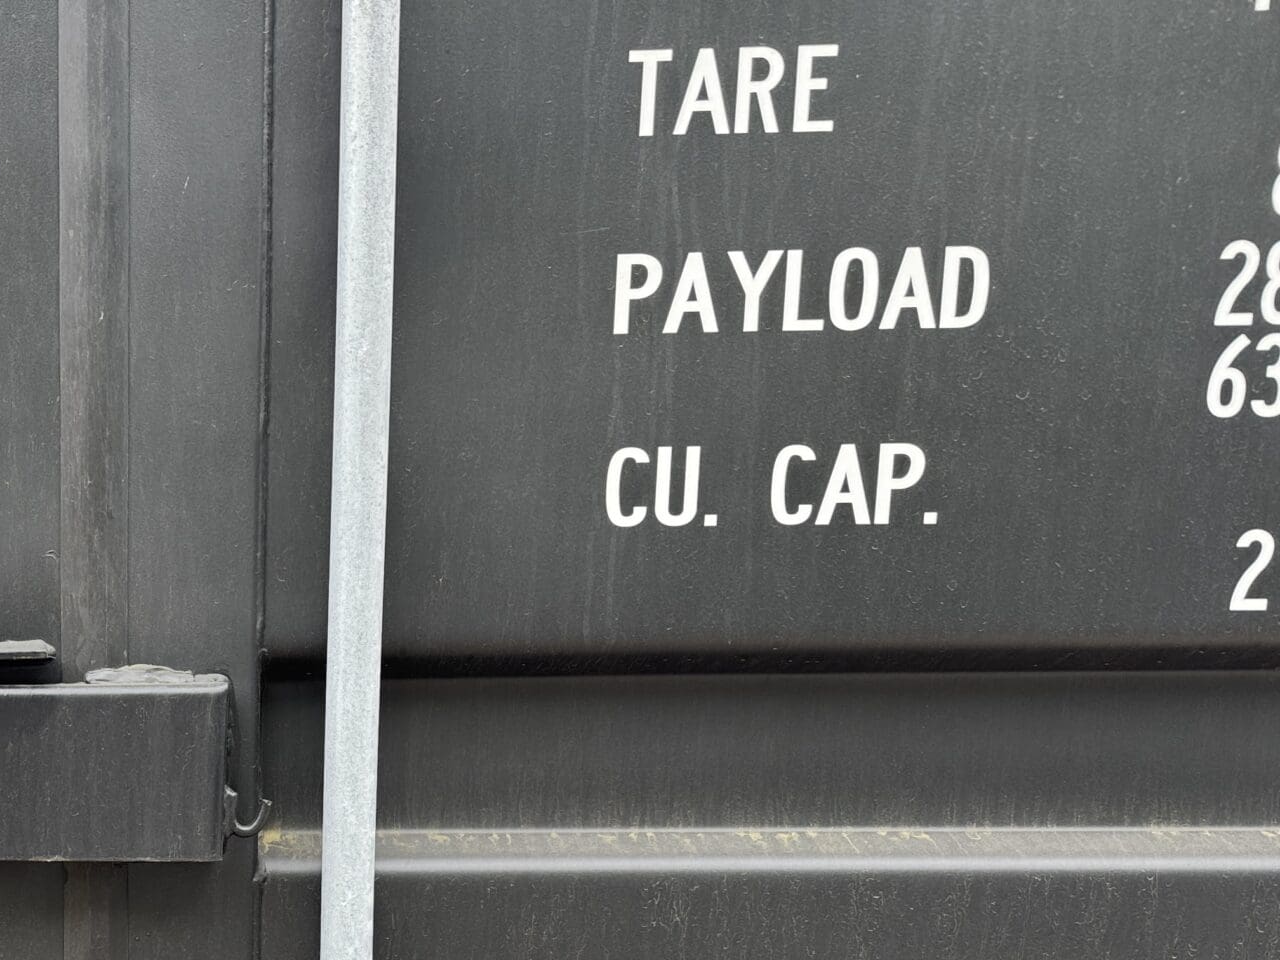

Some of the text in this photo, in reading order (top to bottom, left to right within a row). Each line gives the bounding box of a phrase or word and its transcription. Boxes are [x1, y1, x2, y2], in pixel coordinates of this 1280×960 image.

[628, 43, 839, 137] TARE
[612, 245, 991, 335] PAYLOAD
[605, 442, 939, 527] CU. CAP.
